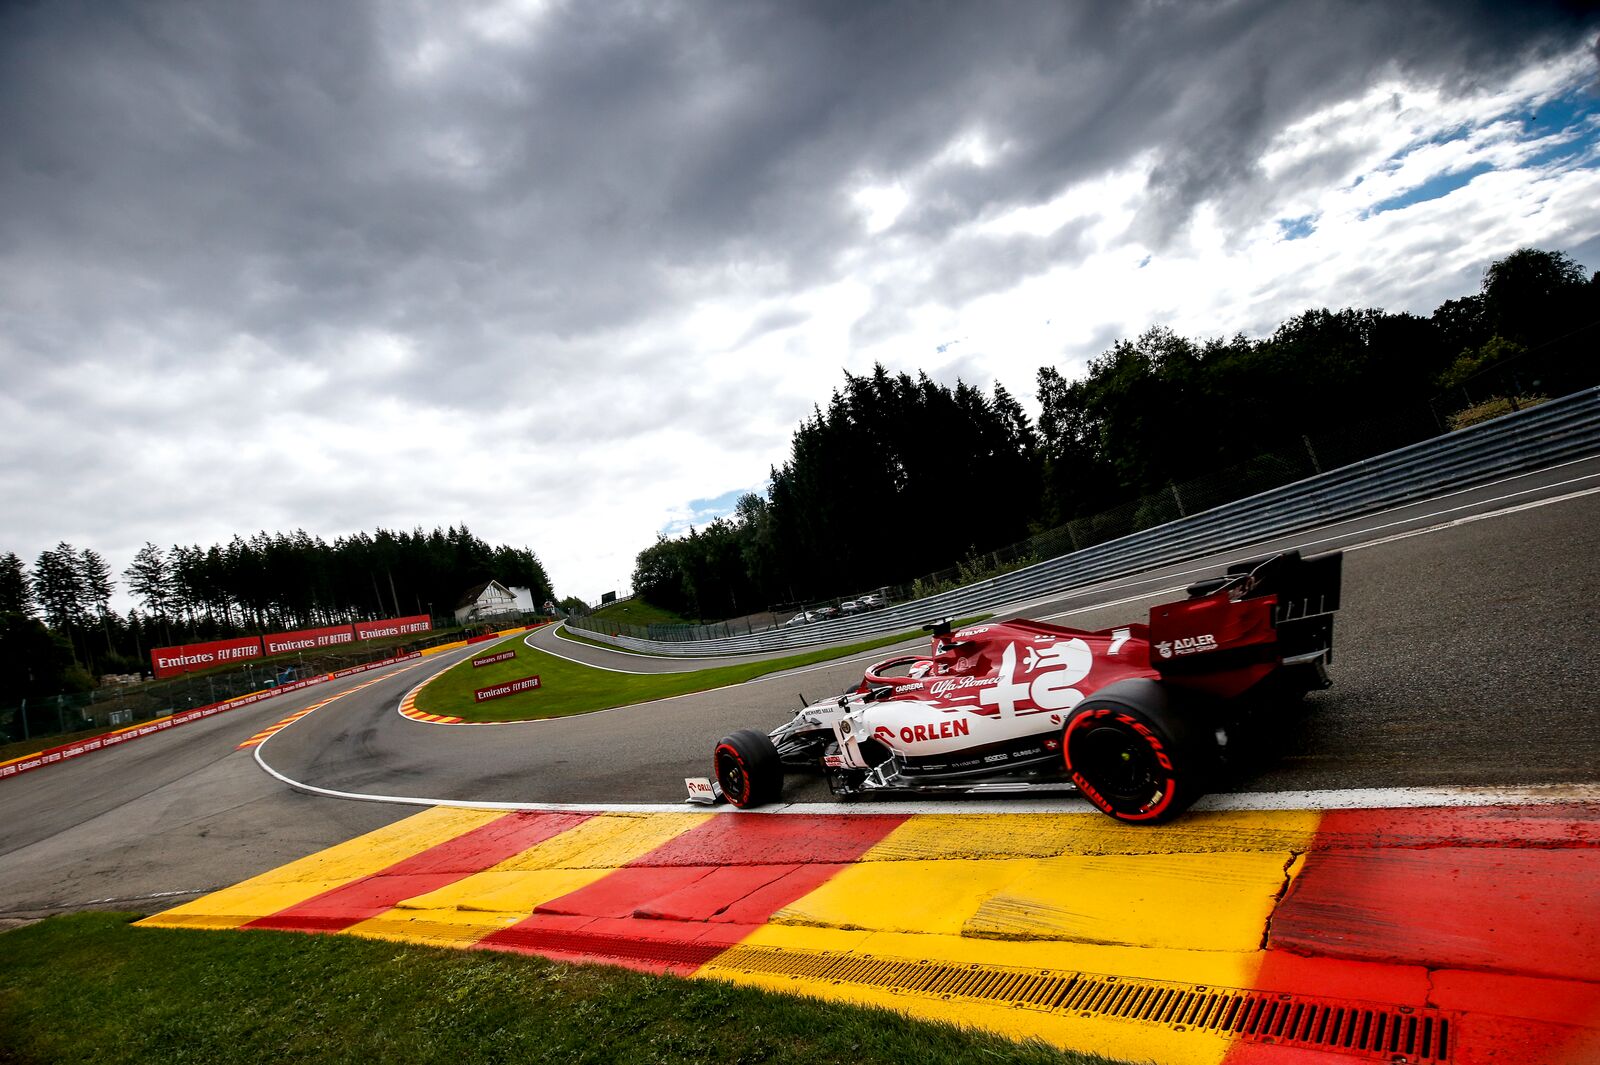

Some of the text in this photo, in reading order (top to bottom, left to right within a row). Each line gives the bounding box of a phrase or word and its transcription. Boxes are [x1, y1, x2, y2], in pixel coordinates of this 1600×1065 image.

[269, 632, 352, 653] Emirates FLY BETTER
[360, 626, 398, 640] Emirates
[954, 628, 989, 638] STELVIO
[1107, 627, 1132, 656] 7
[1174, 634, 1217, 650] ADLER
[158, 645, 258, 669] Emirates FLY BETTER
[477, 678, 539, 700] Emirates FLY BETTER
[895, 682, 924, 693] CARRERA
[930, 675, 1006, 699] Alfa Romeo
[900, 718, 970, 744] ORLEN
[697, 783, 712, 792] ORL
